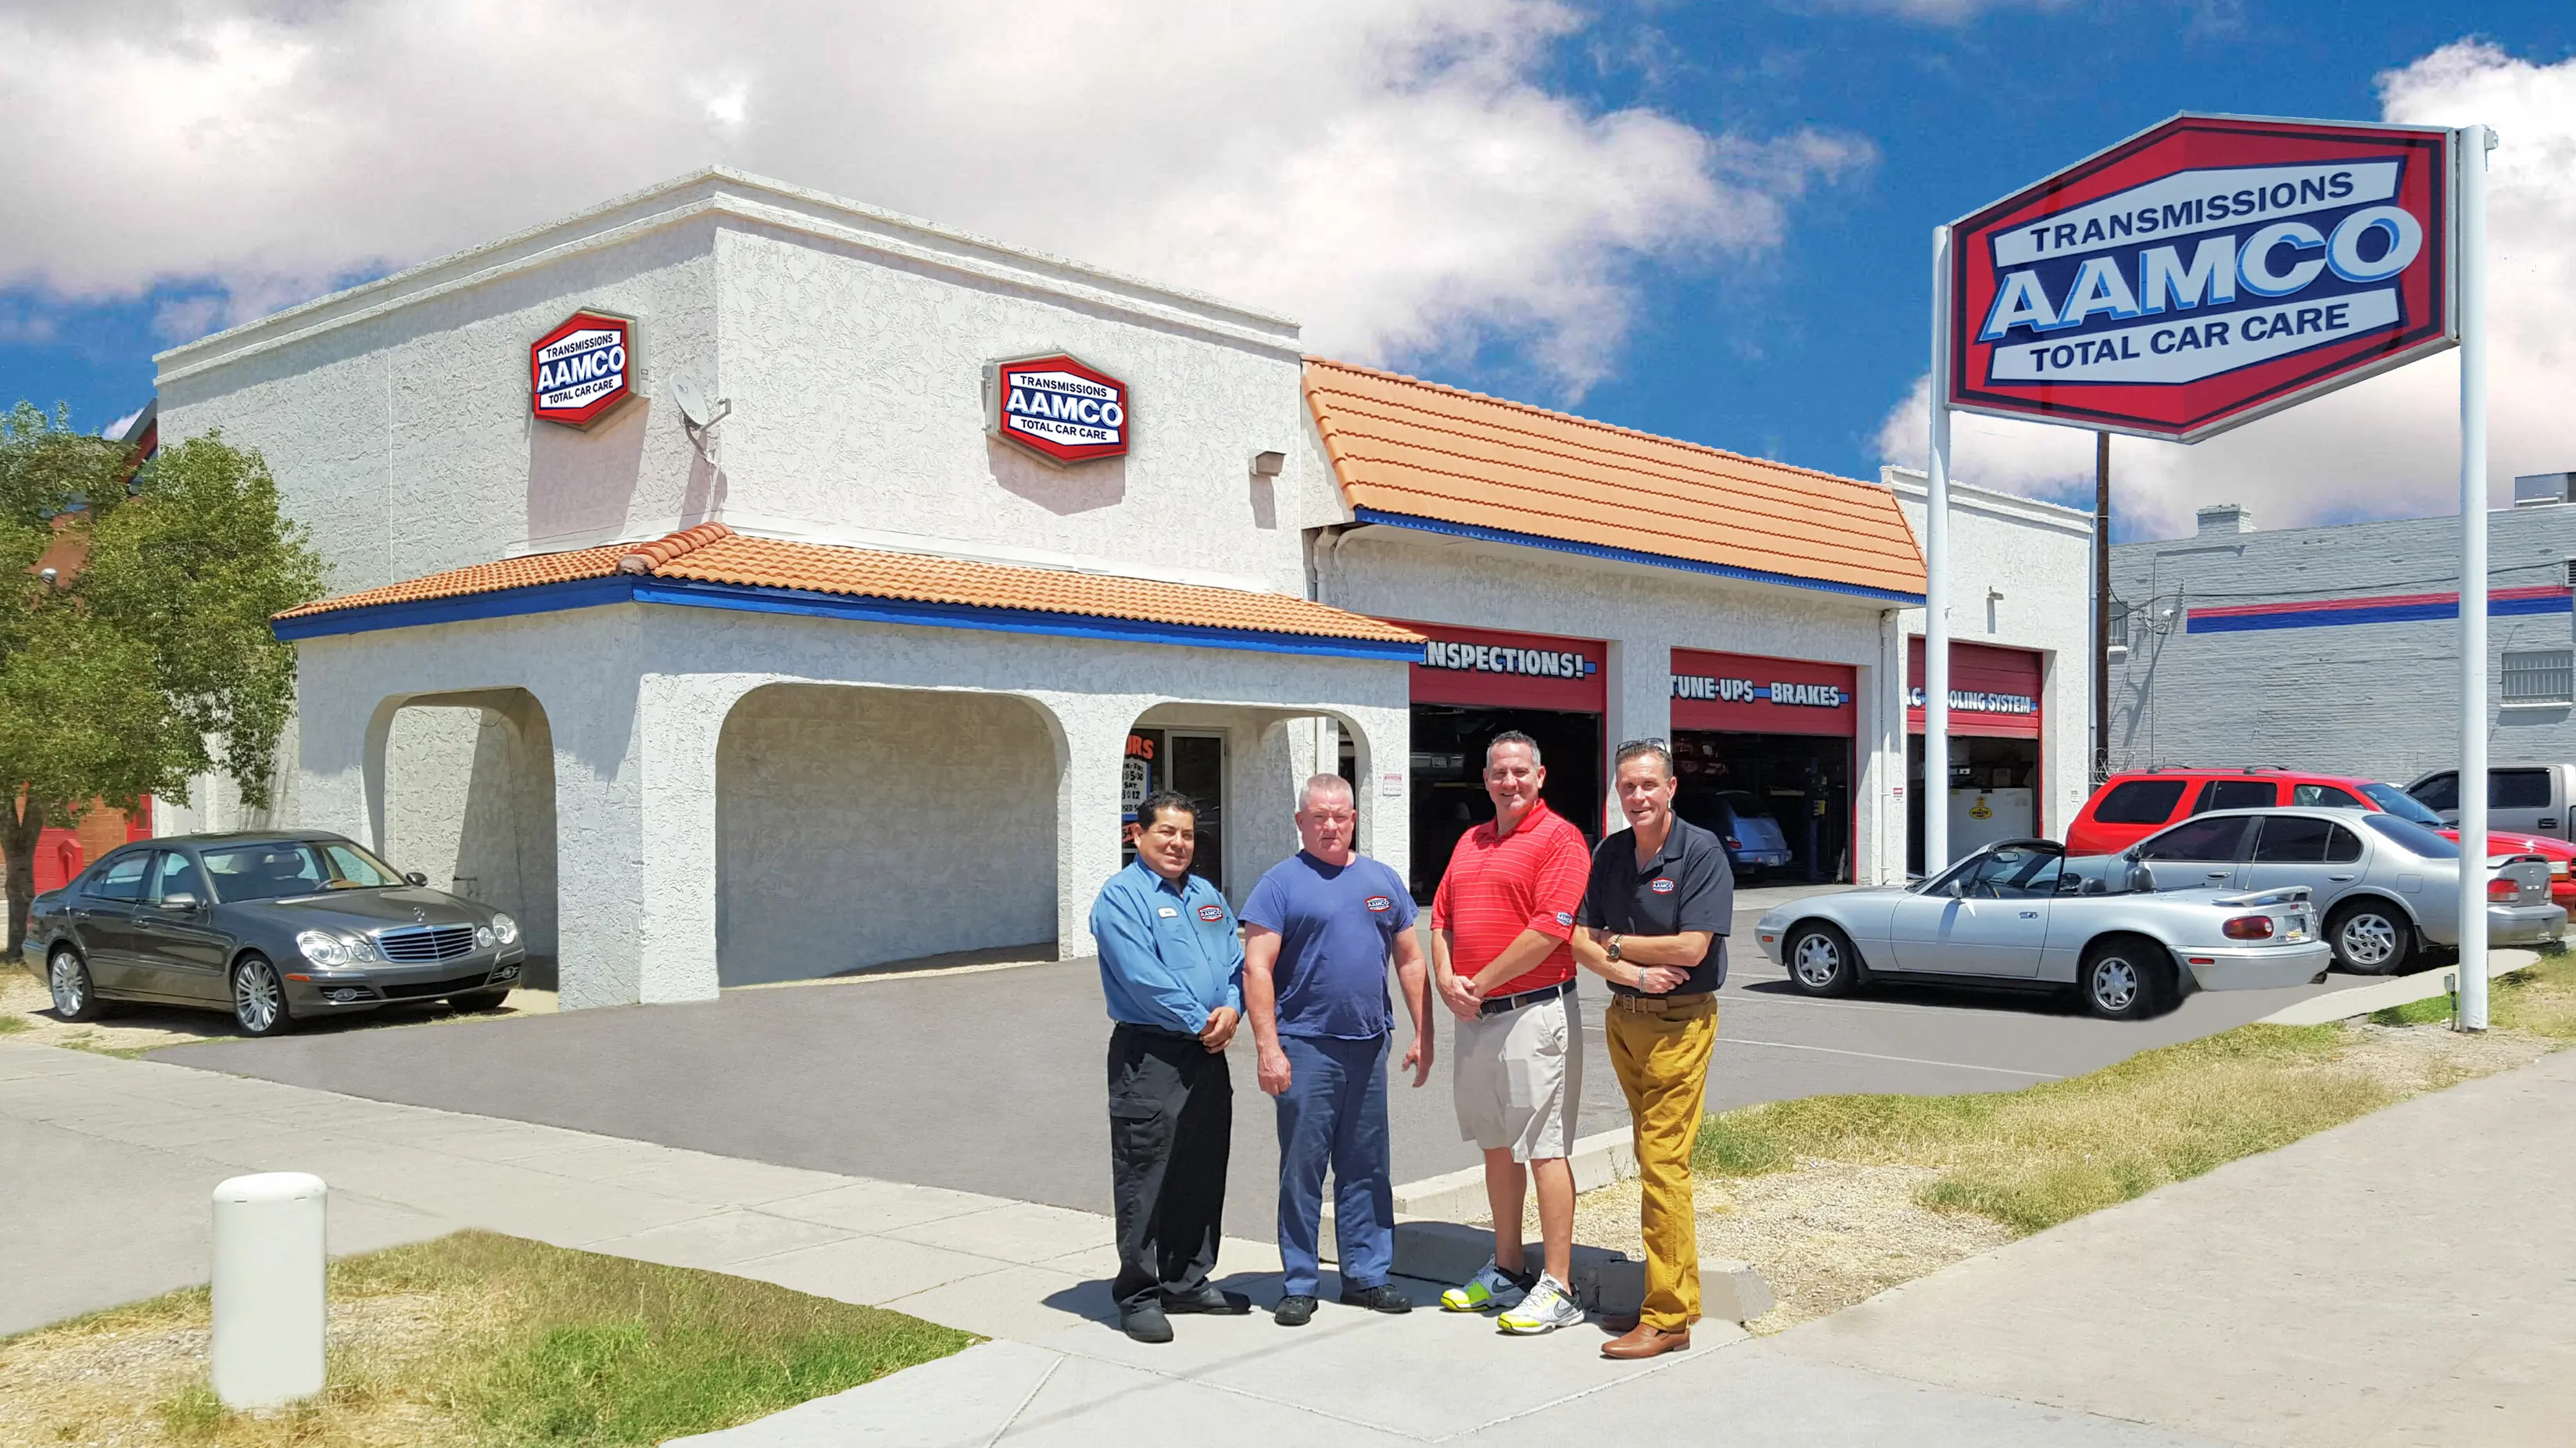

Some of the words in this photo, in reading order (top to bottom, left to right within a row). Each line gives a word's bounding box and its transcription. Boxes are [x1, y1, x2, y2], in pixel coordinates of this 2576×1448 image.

[2030, 172, 2355, 252] TRANSMISSIONS
[1979, 204, 2424, 342] AAMCO
[546, 333, 614, 359] TRANSMISSIONS
[2030, 336, 2141, 372] TOTAL
[2150, 323, 2230, 355] CAR
[2241, 303, 2350, 342] CARE
[536, 346, 625, 393] AAMCO
[549, 391, 574, 405] TOTAL
[575, 386, 592, 397] CAR
[593, 378, 614, 392] CARE
[1020, 375, 1107, 397] TRANSMISSIONS
[1005, 388, 1124, 428] AAMCO
[1021, 418, 1053, 433] TOTAL
[1055, 424, 1077, 435] CAR
[1079, 429, 1107, 440] CARE
[1771, 682, 1840, 707] BRAKES
[1947, 690, 1986, 711] OLING
[1987, 694, 2031, 714] SYSTEM
